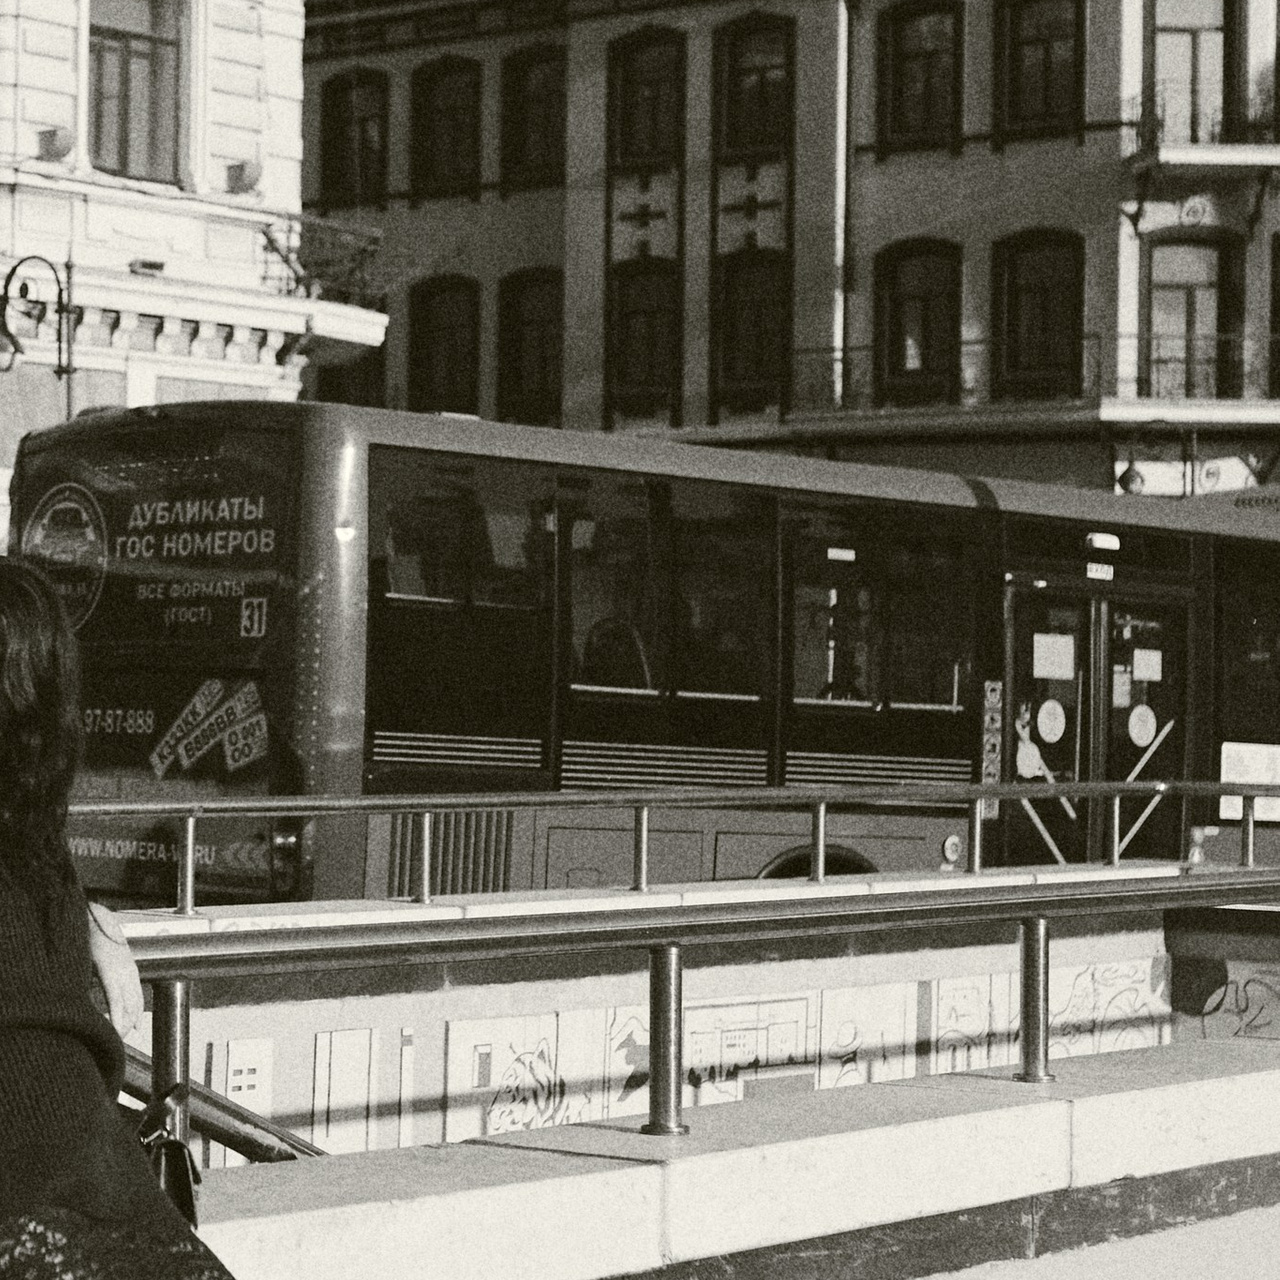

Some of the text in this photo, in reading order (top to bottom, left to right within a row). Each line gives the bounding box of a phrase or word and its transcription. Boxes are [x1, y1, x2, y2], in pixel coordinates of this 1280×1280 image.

[128, 496, 264, 530] ДУБЛИКАТЫ
[116, 529, 275, 558] ГОС НОМЕРОВ
[137, 580, 246, 600] ВСЕ ФОРМАТЫ
